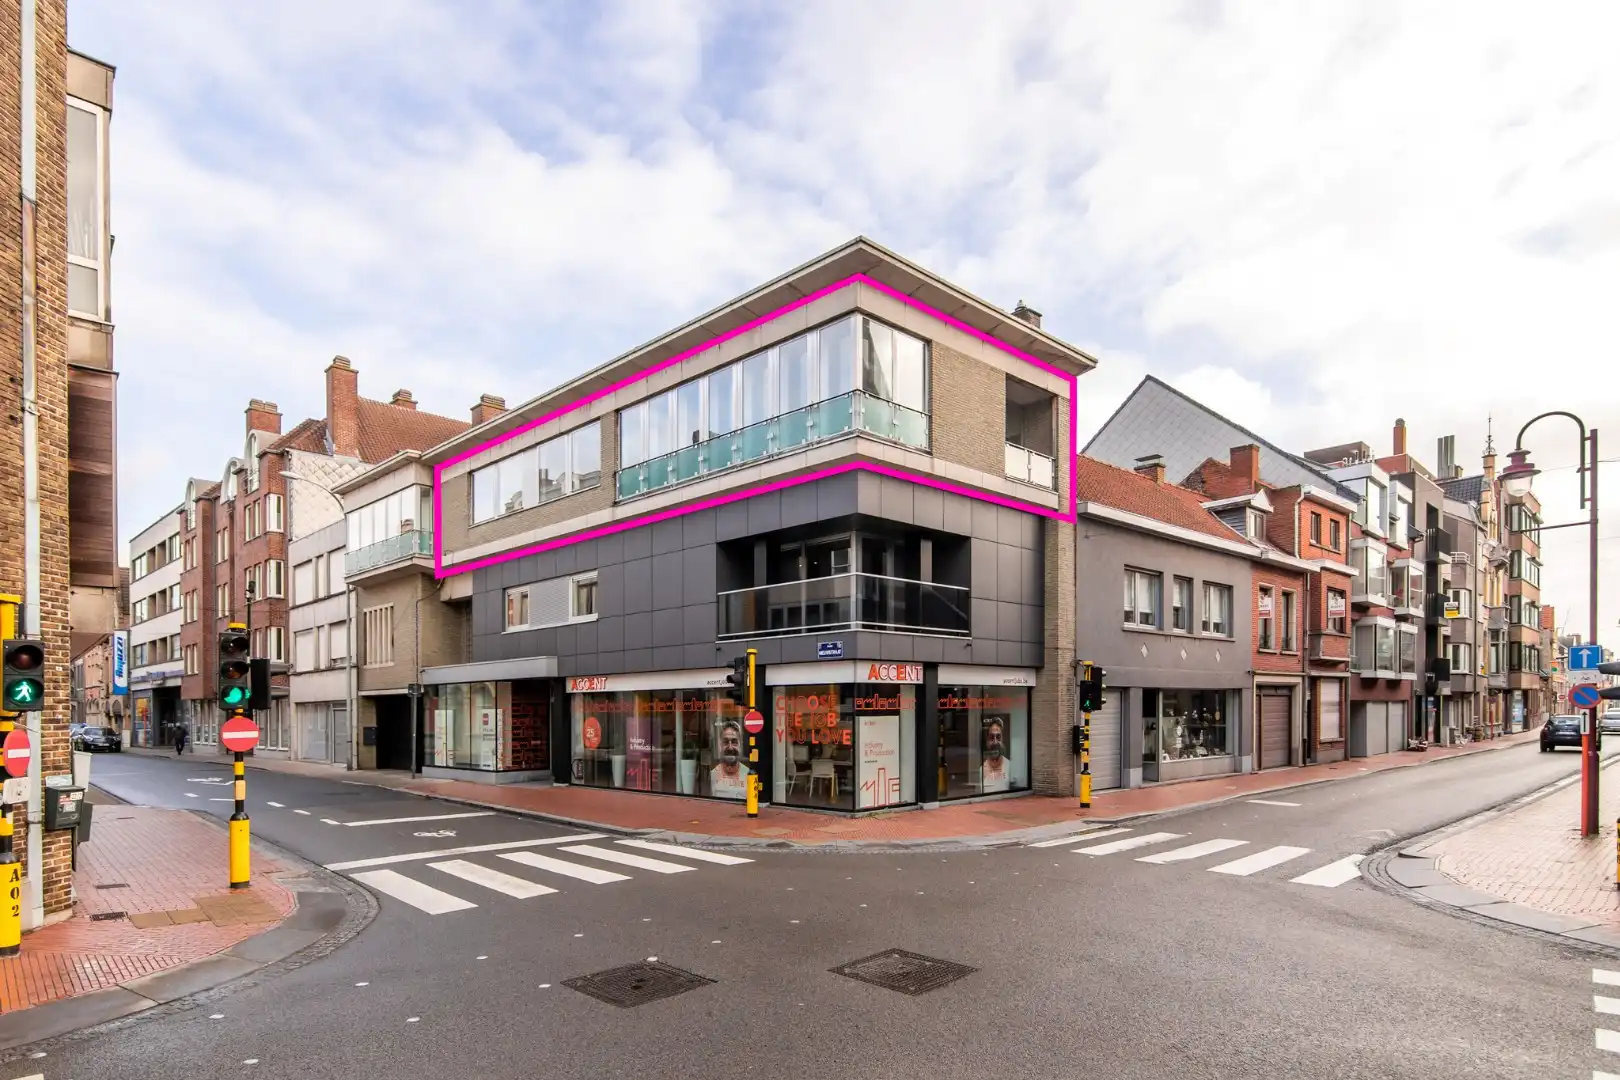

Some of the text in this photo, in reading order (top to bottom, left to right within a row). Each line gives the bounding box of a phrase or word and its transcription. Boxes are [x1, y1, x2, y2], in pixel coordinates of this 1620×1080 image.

[868, 663, 922, 681] ACCENT
[571, 676, 607, 691] ACCENT
[776, 695, 837, 711] CHOOSE
[776, 712, 837, 728] THE JOB
[776, 729, 852, 744] YOU LOVE
